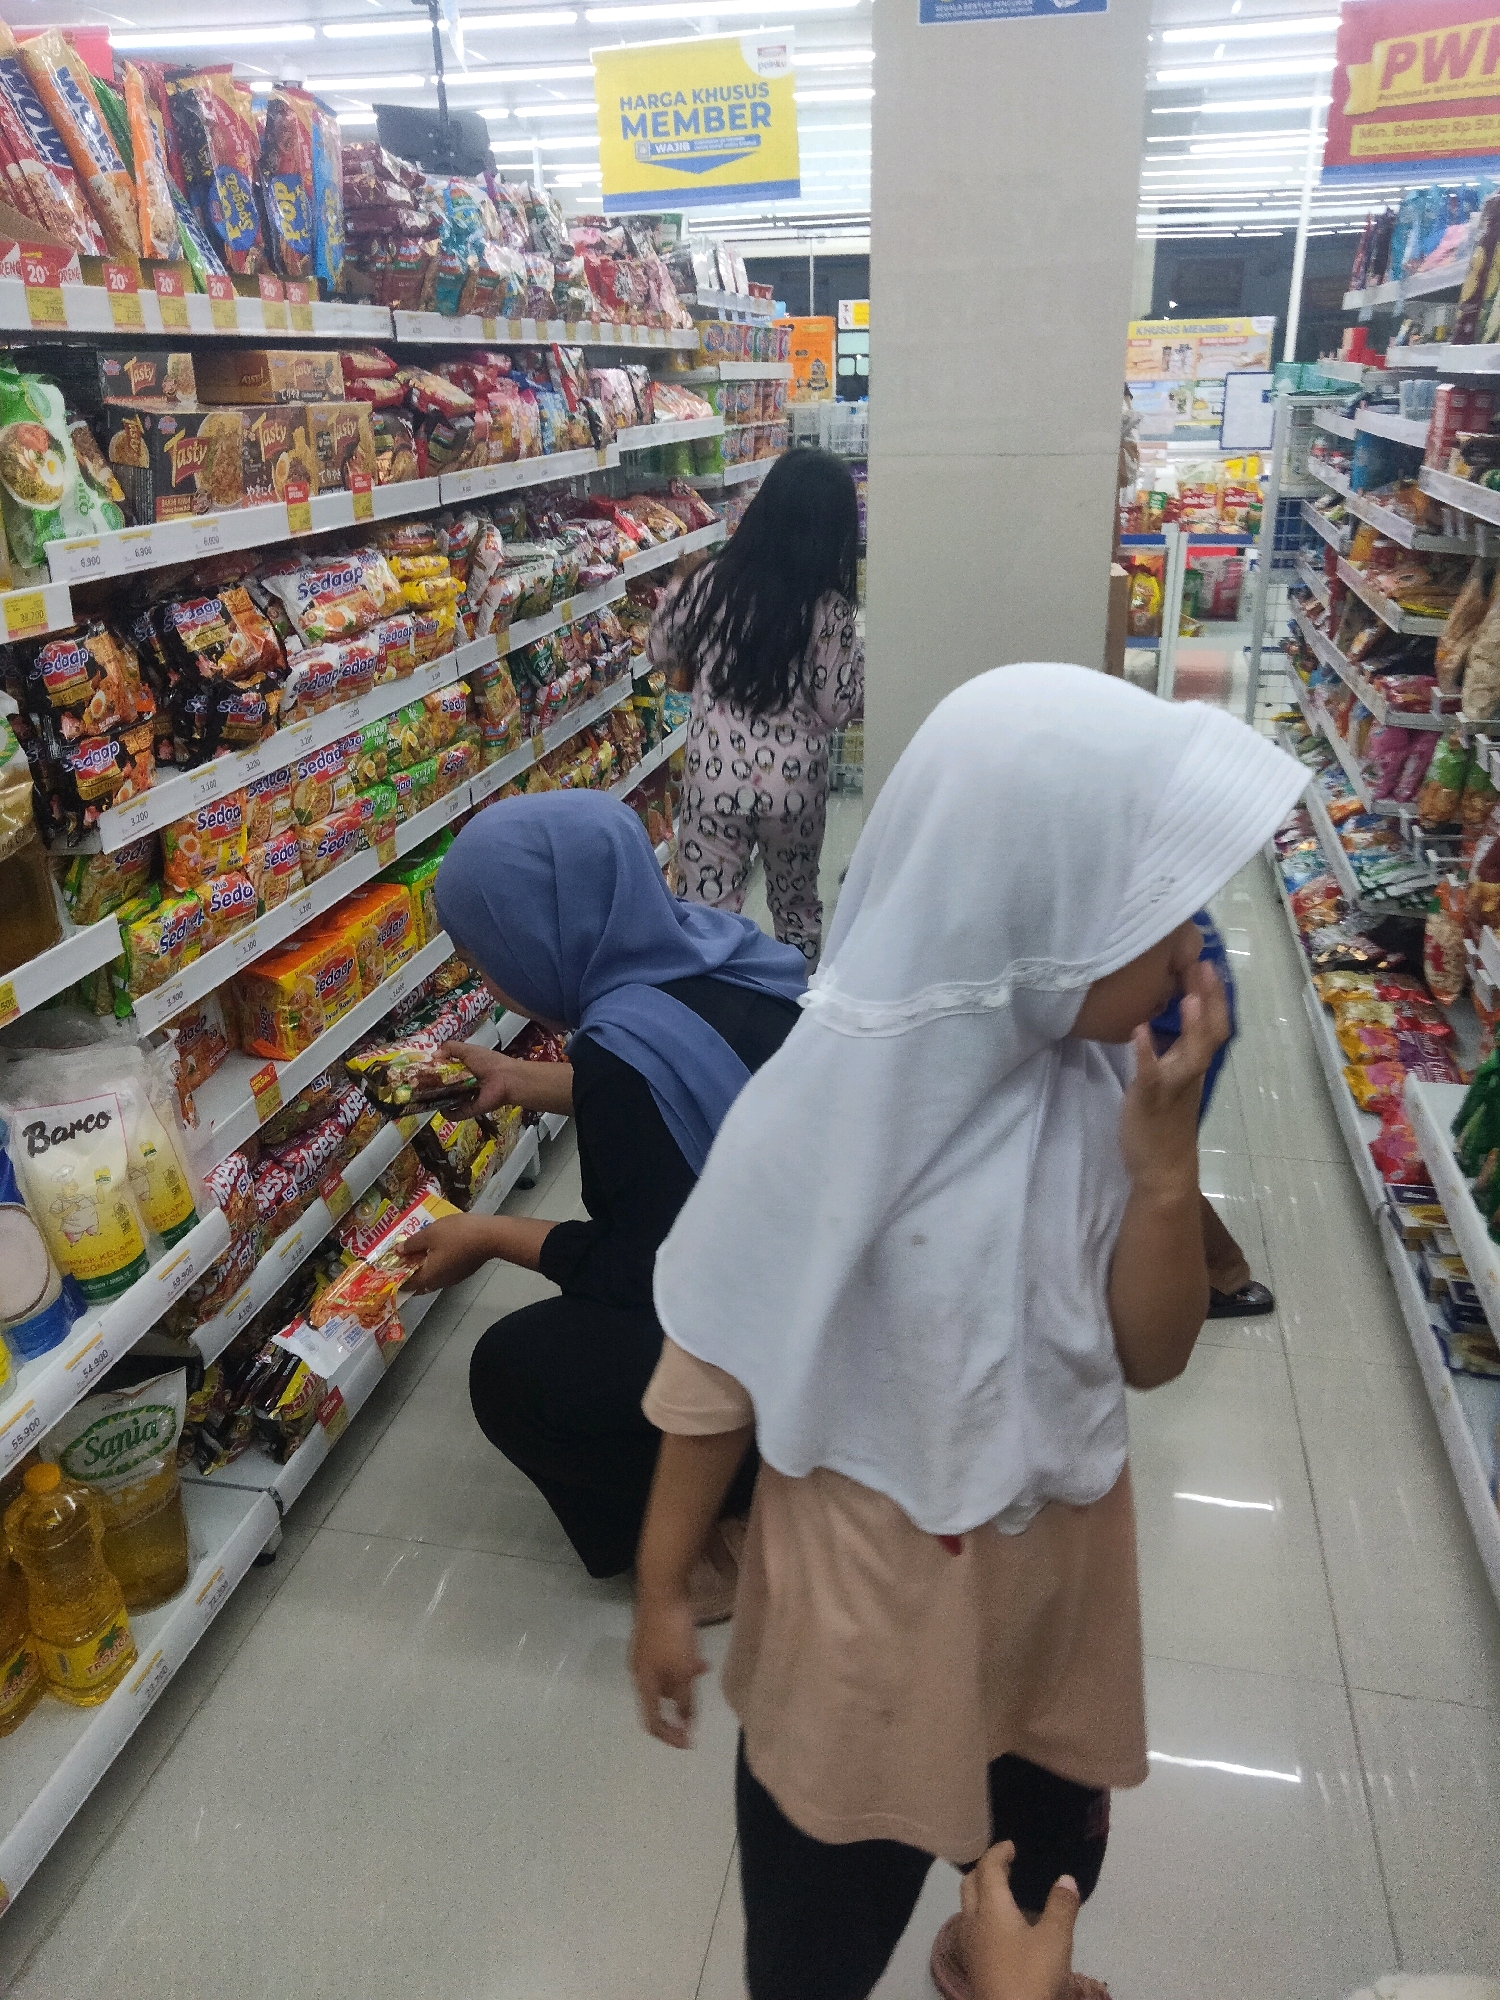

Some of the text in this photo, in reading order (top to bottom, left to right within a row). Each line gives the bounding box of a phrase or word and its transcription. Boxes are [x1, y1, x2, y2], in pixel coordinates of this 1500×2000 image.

[620, 81, 770, 112] HARGA KHUSUS
[621, 101, 772, 140] MEMBER
[655, 141, 690, 154] WAJIB
[273, 181, 301, 241] POP
[124, 356, 155, 395] Tasty
[252, 412, 287, 463] Tasty
[164, 428, 210, 488] Tasty
[297, 565, 364, 601] Sedaap
[163, 598, 222, 632] Sedaap
[378, 623, 415, 645] Sedaap
[29, 647, 89, 681] Sedaap
[289, 666, 339, 699] Sedaap
[61, 740, 120, 773] Sedaap
[296, 747, 342, 780] Sedaa
[197, 804, 241, 831] Sedaa
[212, 880, 228, 892] Mie
[314, 957, 354, 998] Sedaap
[22, 1110, 113, 1159] Barco
[82, 1349, 109, 1379] 54.900
[83, 1417, 159, 1467] Sania
